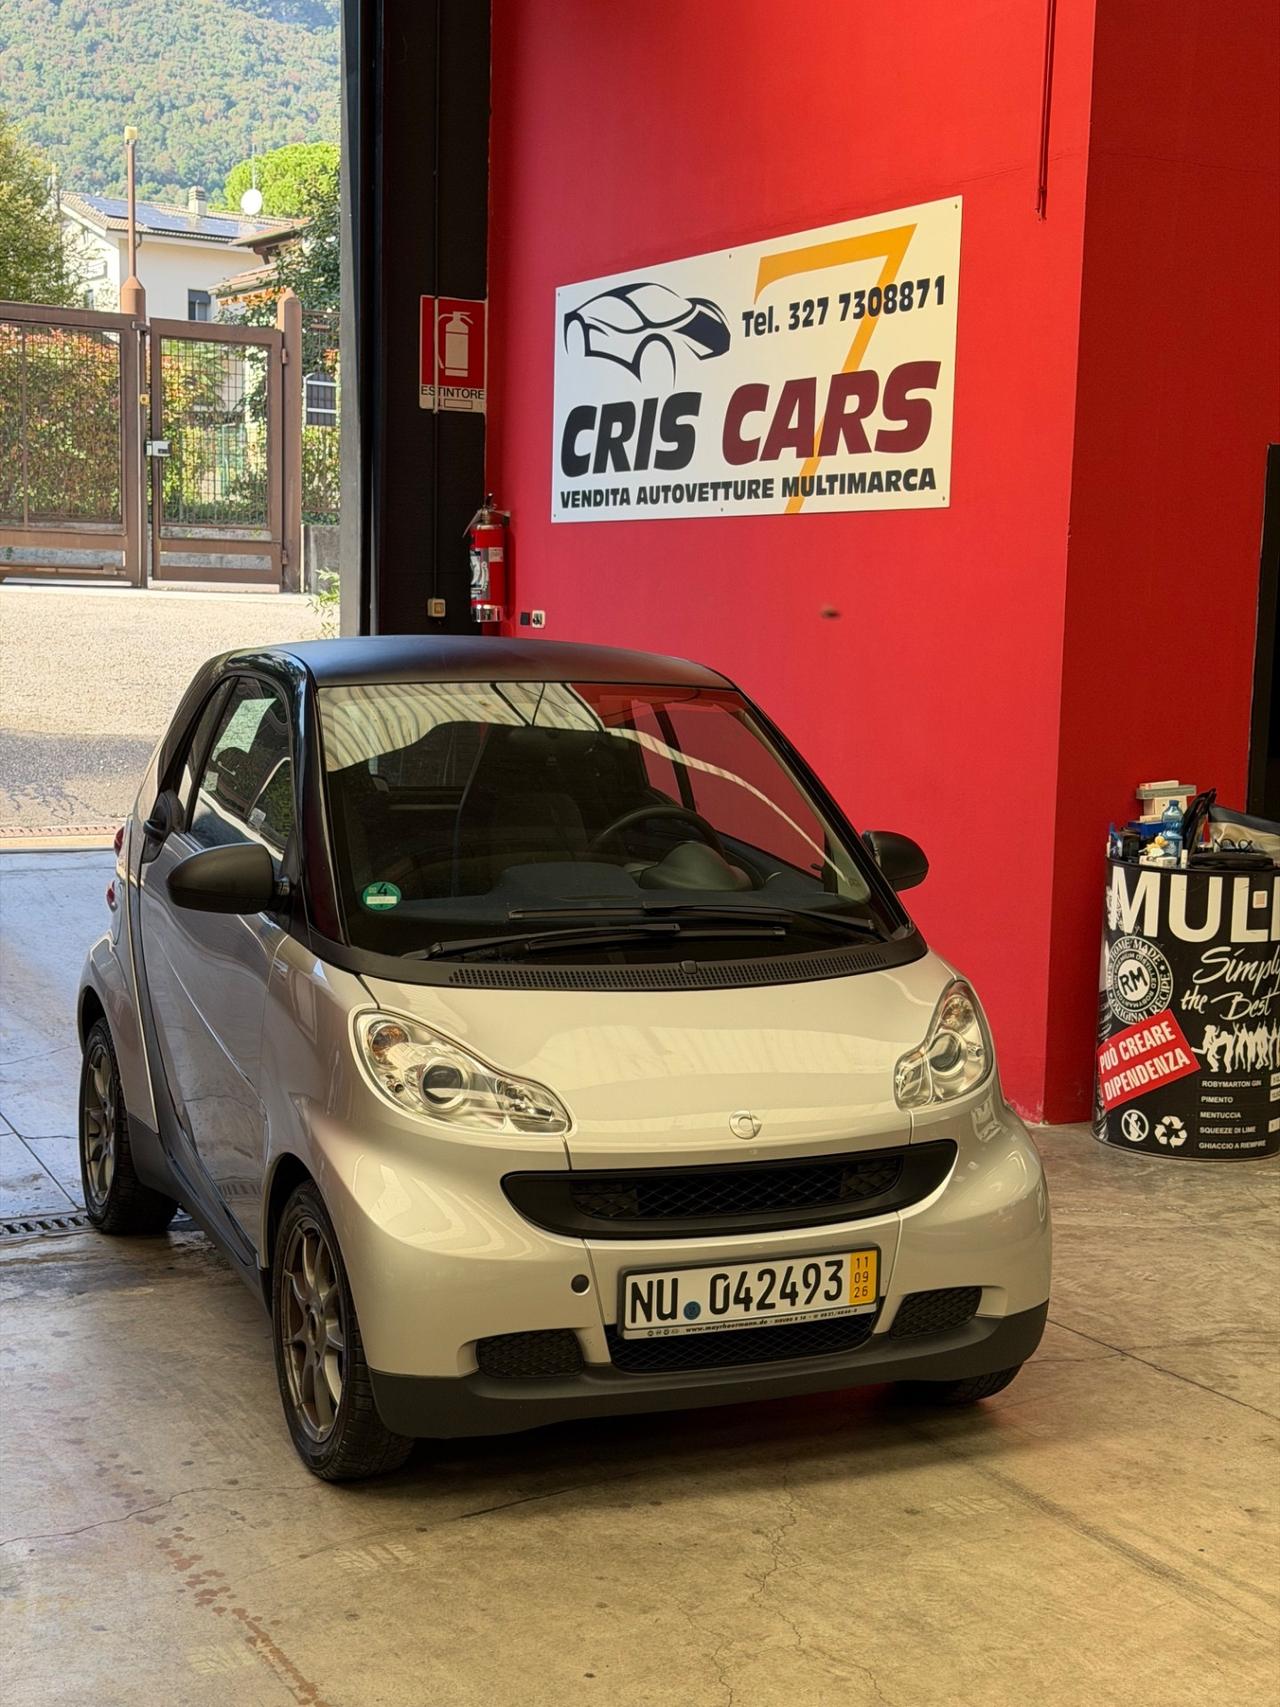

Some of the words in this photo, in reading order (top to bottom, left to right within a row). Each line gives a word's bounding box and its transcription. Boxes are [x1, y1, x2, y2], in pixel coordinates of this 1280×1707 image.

[742, 305, 780, 338] Tel.
[789, 297, 829, 331] 327
[838, 275, 946, 322] 7308871
[421, 385, 485, 399] ESTINTORE
[560, 391, 703, 478] CRIS
[721, 360, 942, 466] CARS
[560, 487, 632, 509] VENDITA
[636, 477, 775, 506] AUTOVETTURE
[781, 467, 936, 499] MULTIMARCA
[377, 883, 388, 897] 4
[1112, 866, 1280, 943] MUL
[1133, 939, 1162, 965] MADE
[1119, 966, 1149, 996] RM
[1180, 985, 1209, 1014] the
[1210, 987, 1280, 1020] Best
[1100, 1043, 1119, 1075] PUÒ
[1118, 1020, 1176, 1061] CREARE
[1103, 1047, 1191, 1101] DIPENDENZA
[1201, 1080, 1251, 1088] ROBYMARTON
[1199, 1111, 1241, 1119] MENTUCCIA
[1199, 1126, 1233, 1134] SQUEEZE
[1198, 1142, 1234, 1150] GHIACCIO
[856, 1256, 868, 1269] 11
[854, 1271, 869, 1283] 09
[631, 1277, 679, 1324] NU
[709, 1259, 844, 1315] 042493
[854, 1286, 868, 1298] 26
